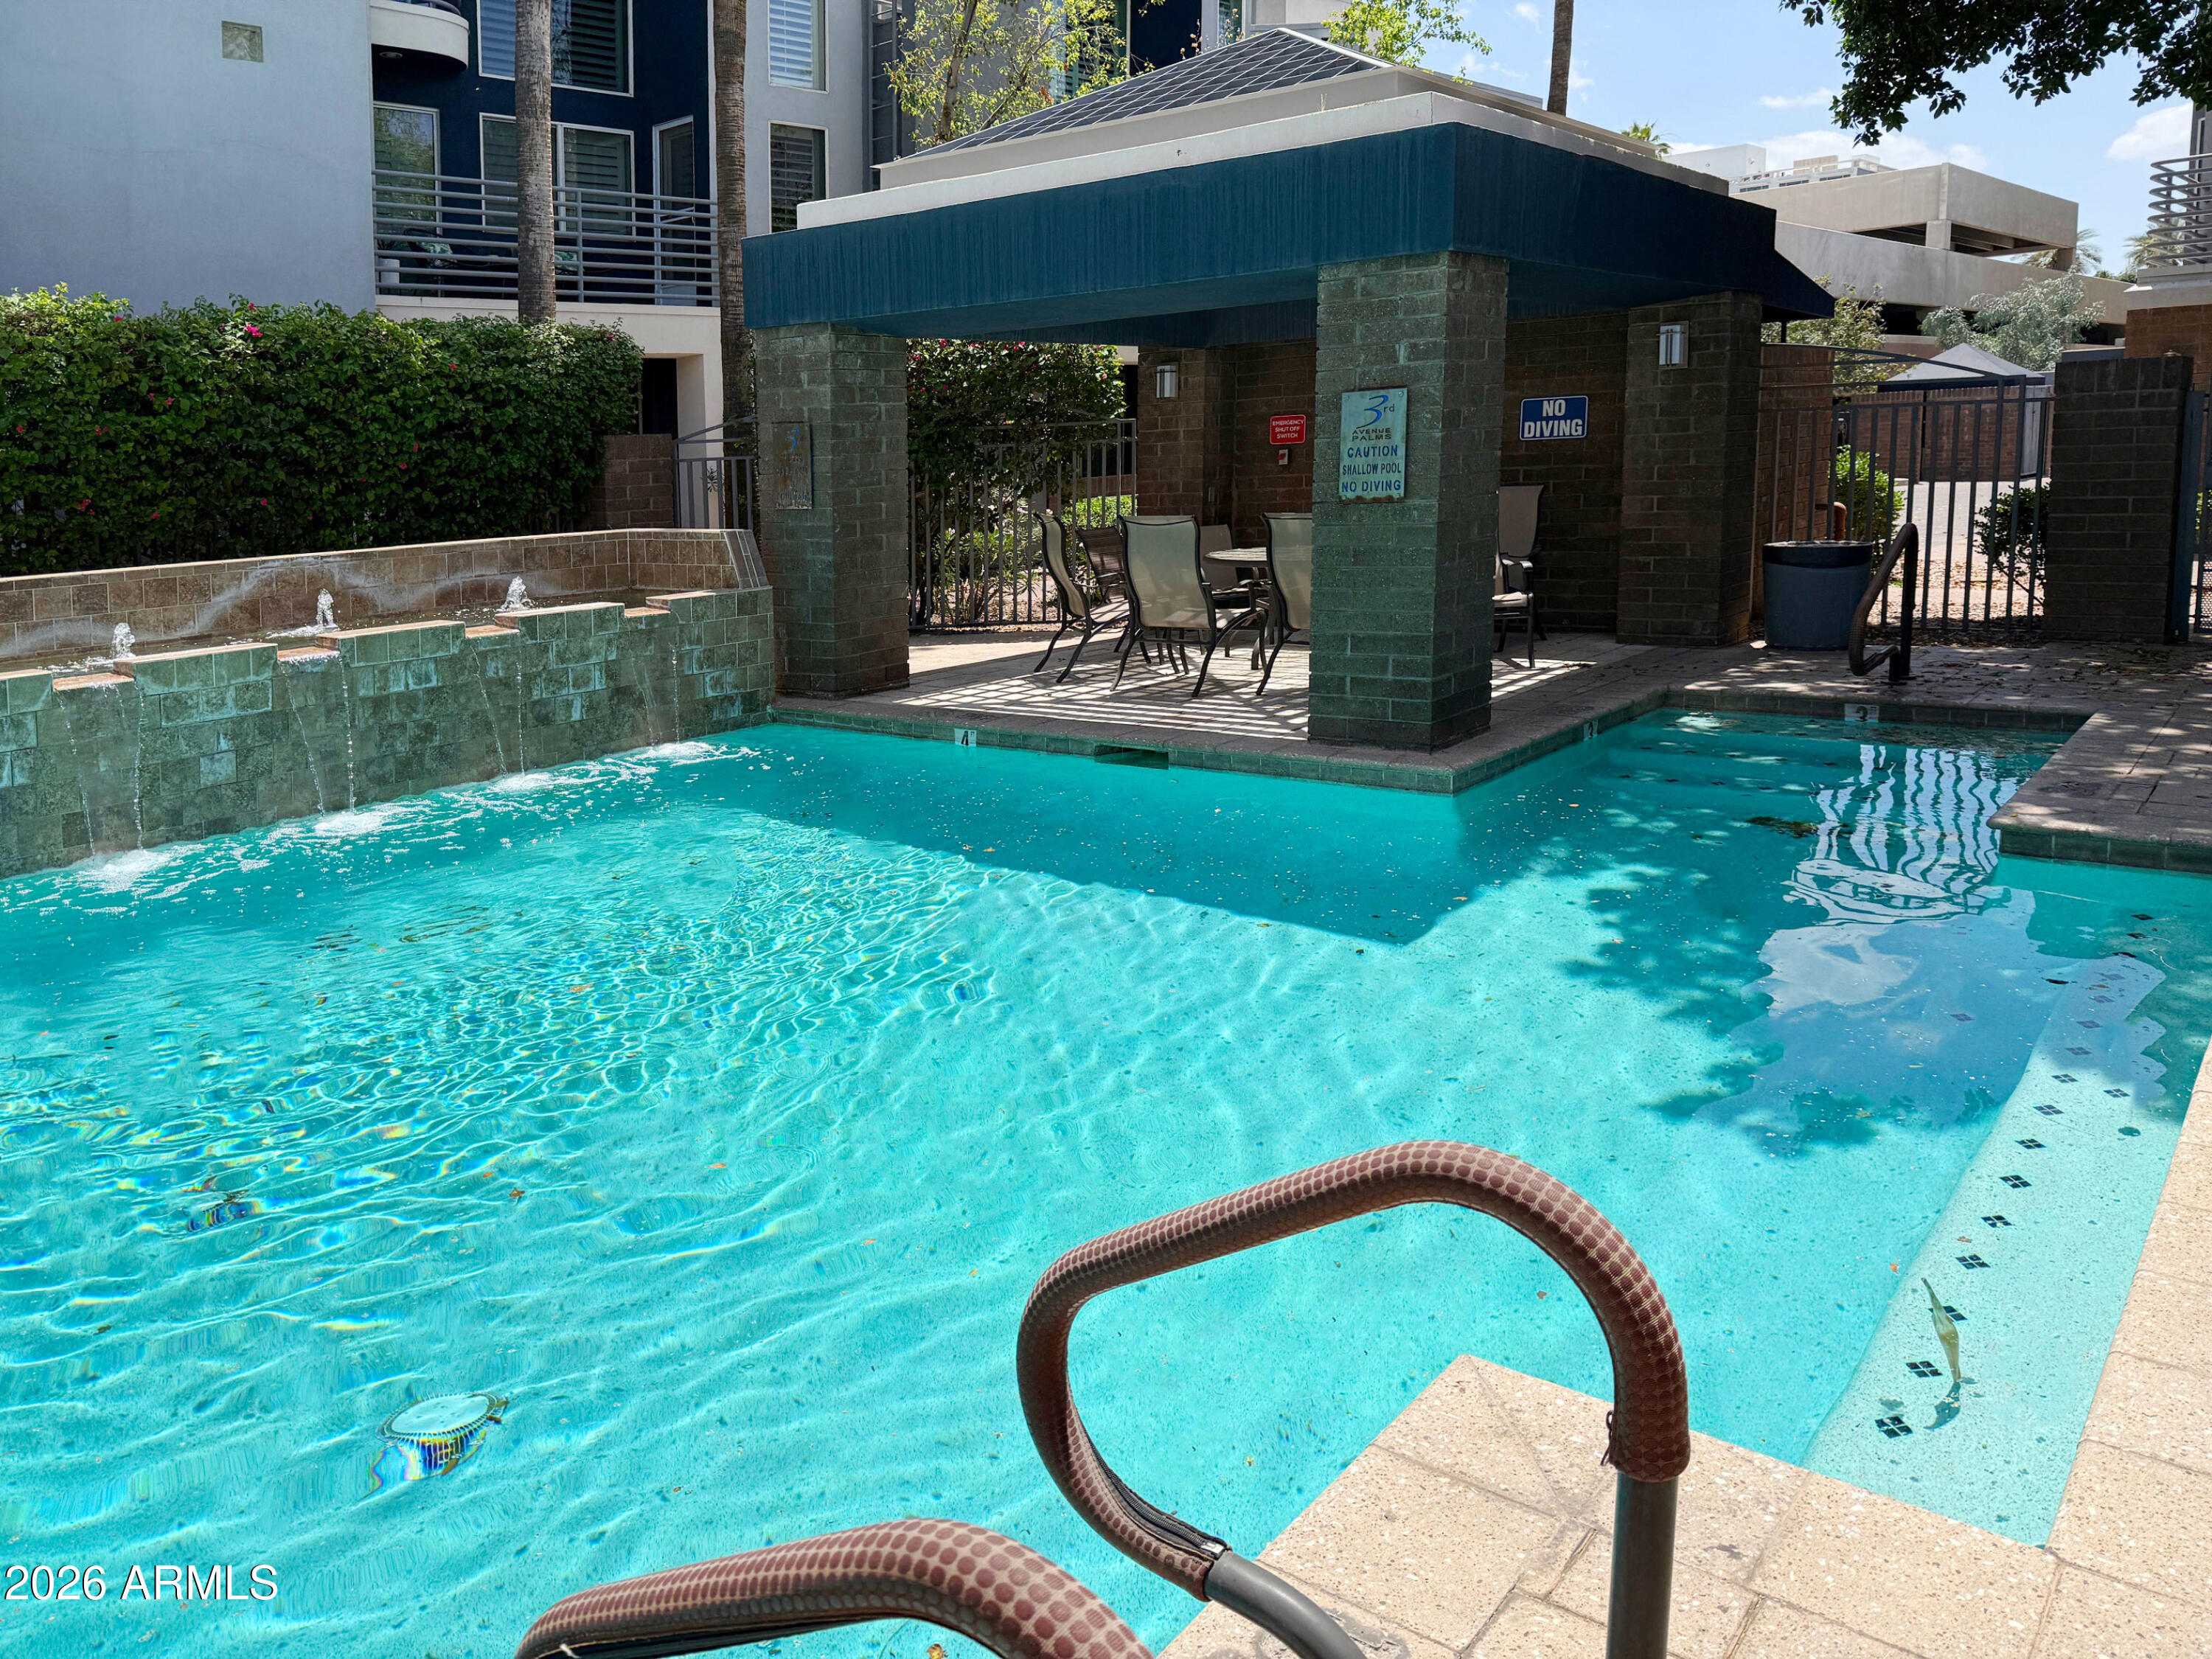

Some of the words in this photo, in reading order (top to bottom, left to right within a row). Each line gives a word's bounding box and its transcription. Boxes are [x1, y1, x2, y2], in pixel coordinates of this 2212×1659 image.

[1356, 394, 1395, 429] 3rd
[1543, 400, 1565, 417] NO
[1524, 419, 1582, 437] DIVING
[1352, 434, 1392, 442] PALMS
[1347, 445, 1398, 458] CAUTION
[1342, 464, 1378, 476] SHALLOW
[1380, 462, 1402, 474] POOL
[1341, 481, 1357, 492] NO
[1361, 479, 1401, 492] DIVING
